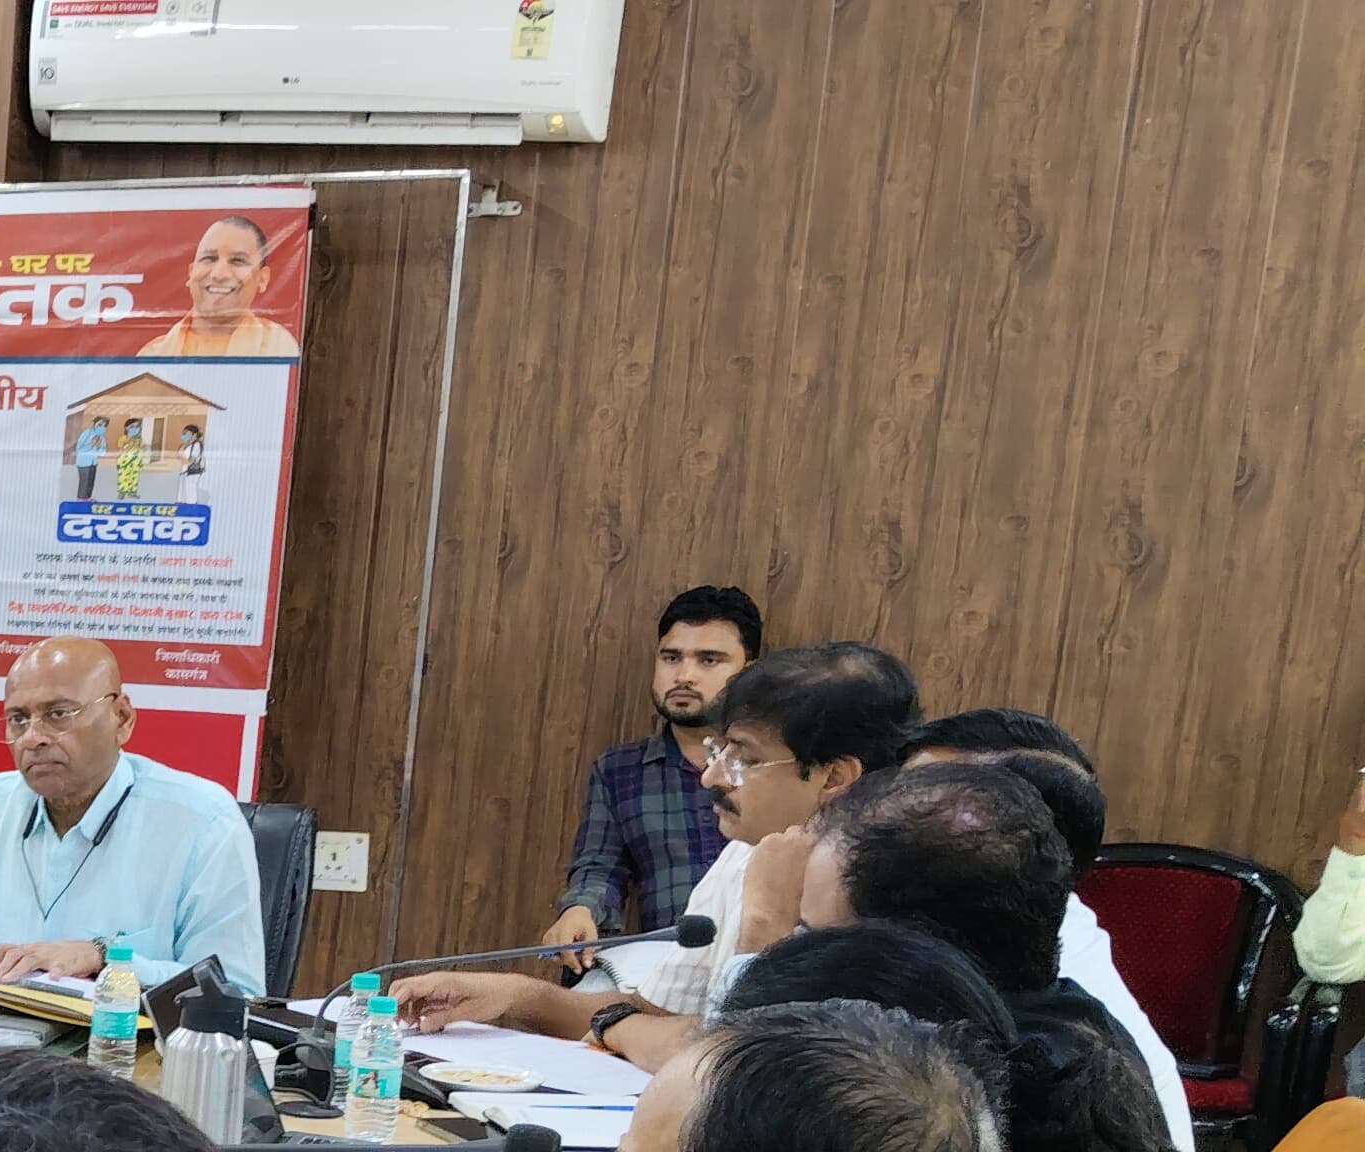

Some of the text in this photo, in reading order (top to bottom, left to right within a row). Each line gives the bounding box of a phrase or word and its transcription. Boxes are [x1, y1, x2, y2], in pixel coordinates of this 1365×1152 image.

[10, 254, 50, 275] घर
[54, 253, 95, 273] पर
[62, 514, 206, 542] दस्तक
[155, 648, 221, 664] जिलाधिकारी
